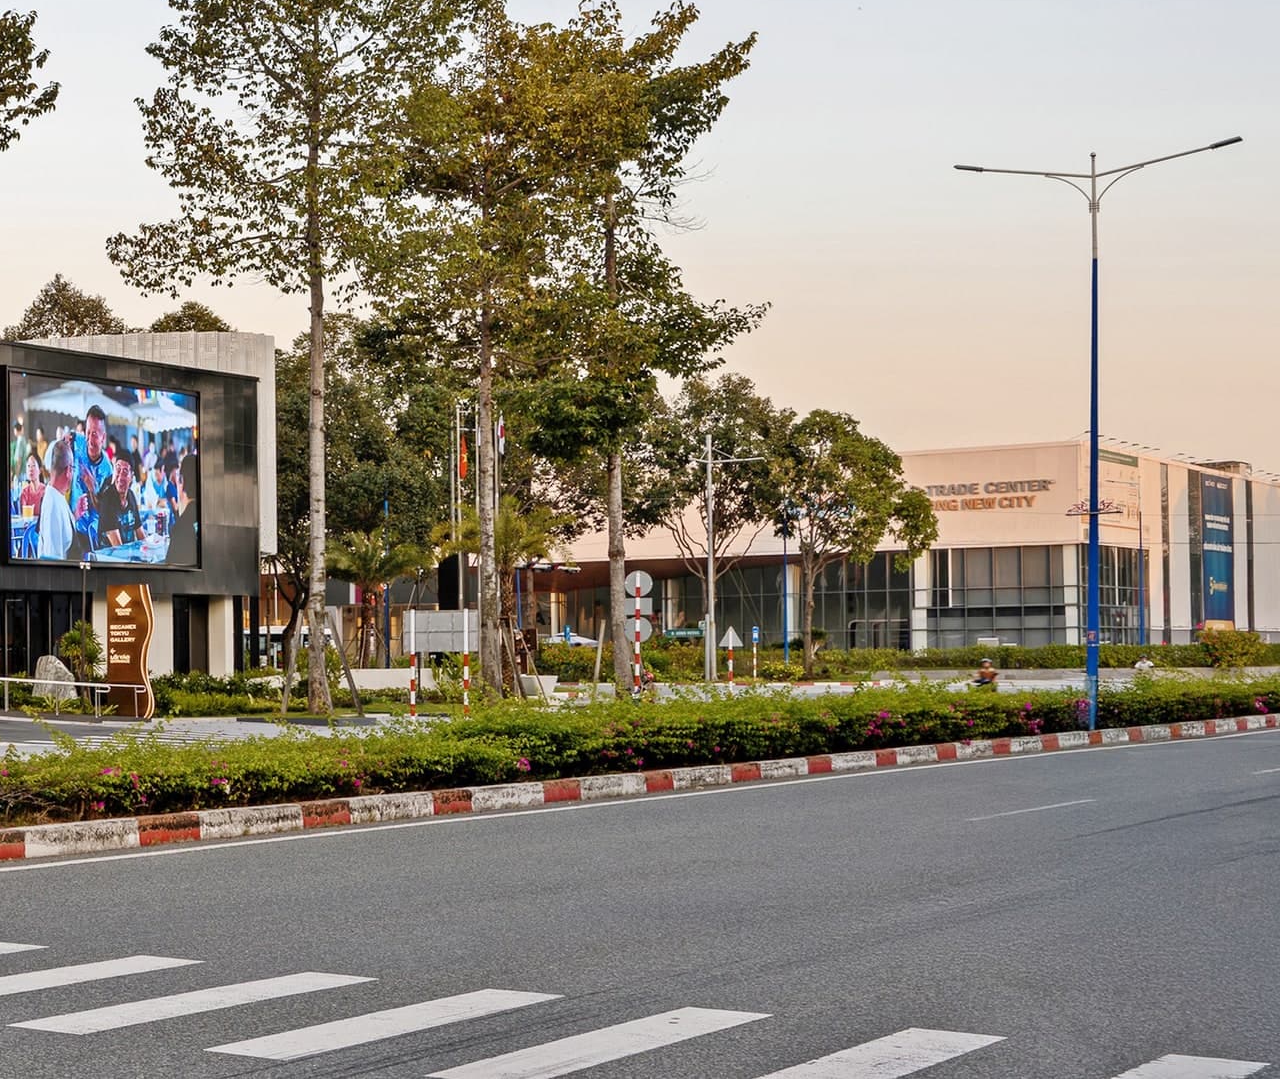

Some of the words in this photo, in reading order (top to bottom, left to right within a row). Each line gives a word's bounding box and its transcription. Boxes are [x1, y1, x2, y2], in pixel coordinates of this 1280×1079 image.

[927, 483, 979, 497] TRADE
[984, 479, 1049, 494] CENTER
[961, 497, 996, 511] NEW
[998, 495, 1036, 509] CITY
